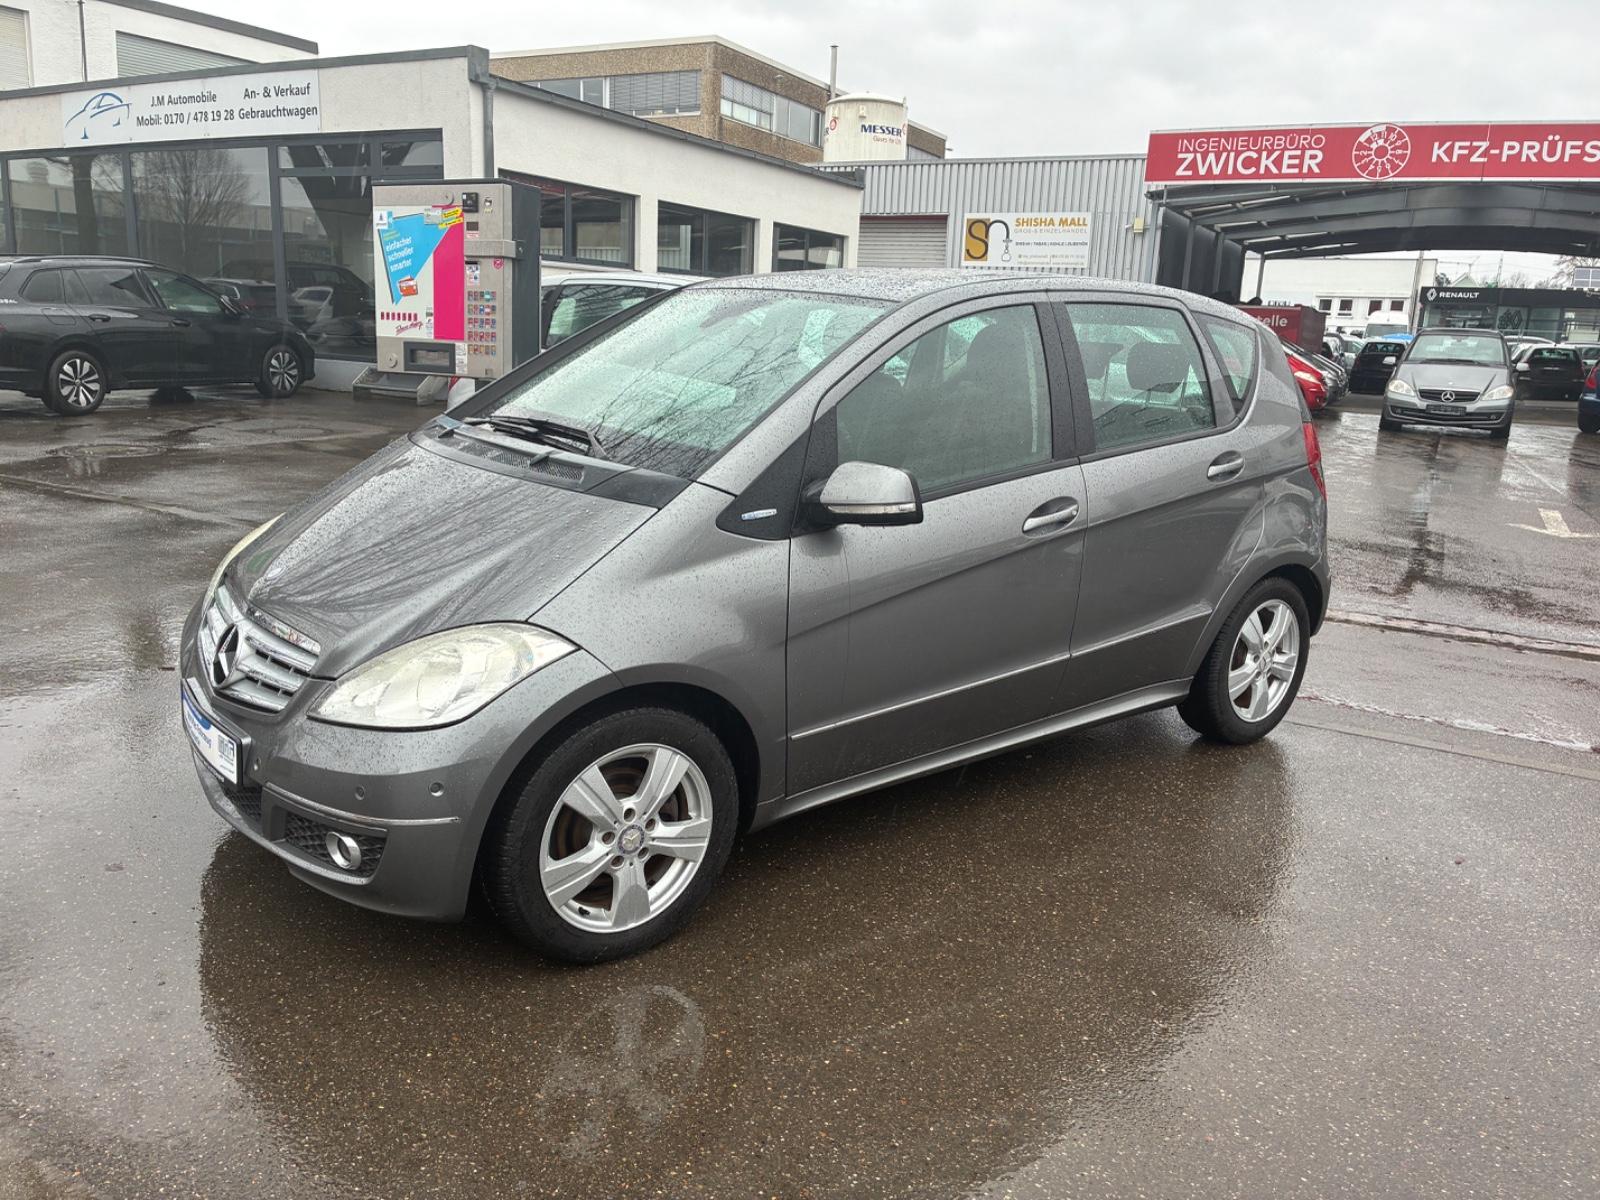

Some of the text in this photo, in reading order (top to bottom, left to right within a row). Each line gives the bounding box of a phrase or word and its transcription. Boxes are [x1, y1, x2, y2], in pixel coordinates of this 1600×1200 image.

[151, 91, 217, 107] J.M Automobile
[243, 83, 311, 100] An- & Verkauf
[136, 114, 162, 127] Mobil:
[164, 112, 185, 125] 0170
[193, 110, 208, 123] 478
[211, 109, 221, 122] 19
[223, 109, 235, 121] 28
[238, 105, 318, 120] Gebrauchtwagen
[861, 124, 902, 137] MESSER
[1177, 133, 1326, 152] INGENIEURBÜRO
[1431, 135, 1600, 163] KFZ-PRÜFS
[1175, 149, 1324, 176] ZWICKER
[1015, 216, 1088, 227] SHISHA MALL
[1439, 291, 1480, 299] RENAULT
